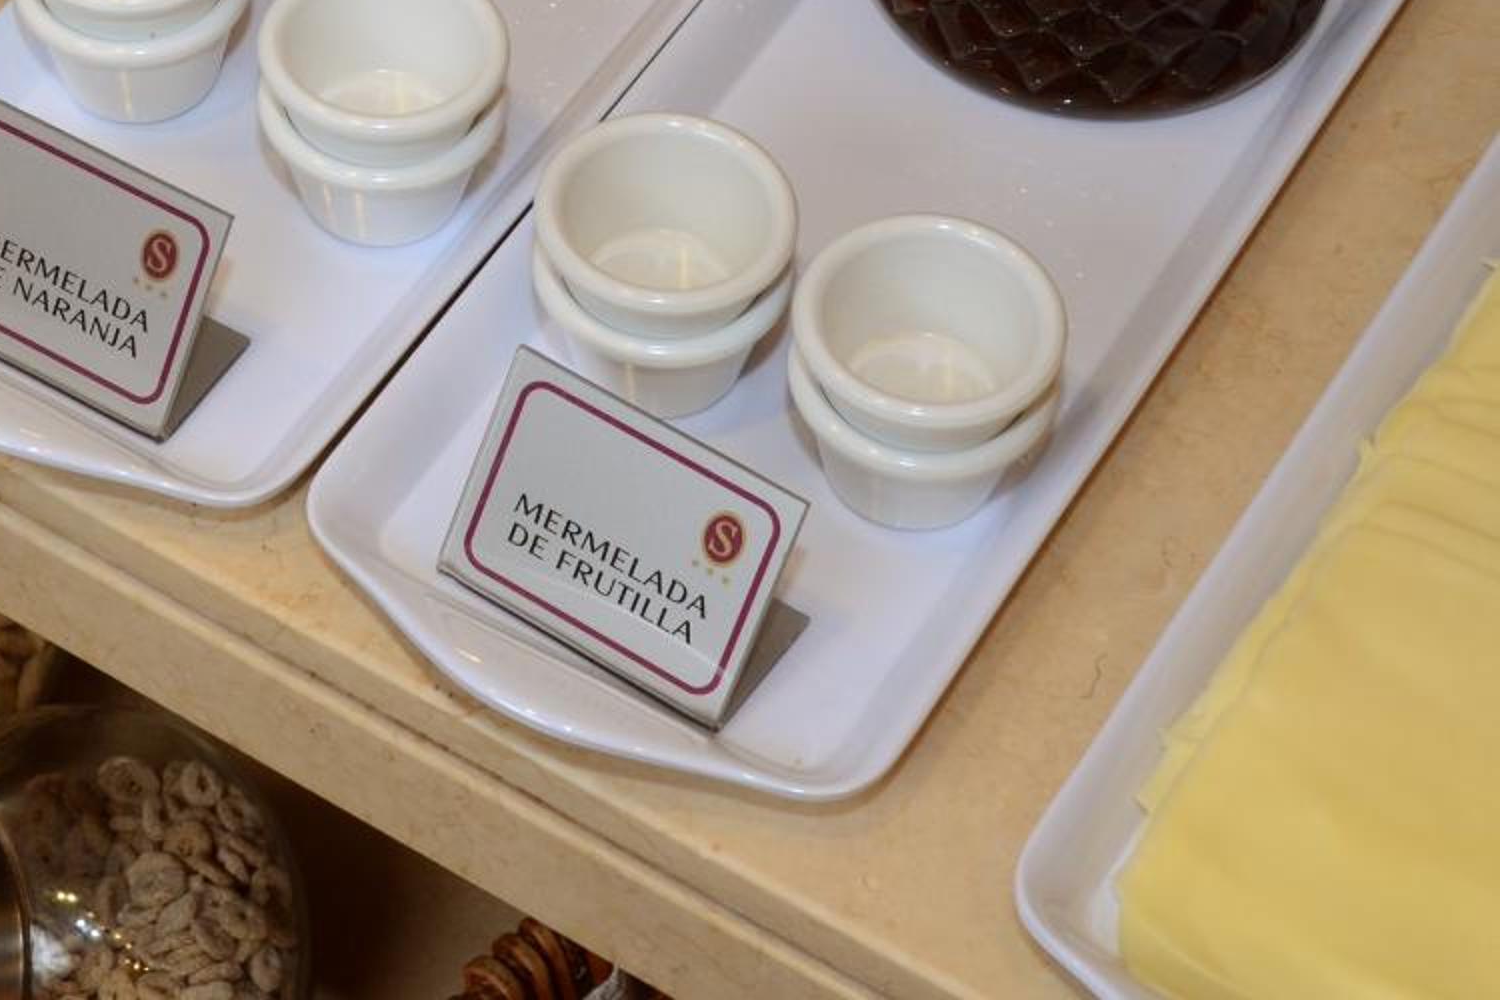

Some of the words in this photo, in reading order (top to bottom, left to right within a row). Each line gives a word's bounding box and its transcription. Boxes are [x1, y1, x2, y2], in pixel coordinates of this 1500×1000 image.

[12, 276, 139, 360] NARANJA
[506, 522, 549, 561] DE
[555, 550, 693, 645] FRUTILLA
[513, 492, 709, 620] MERMELADA
